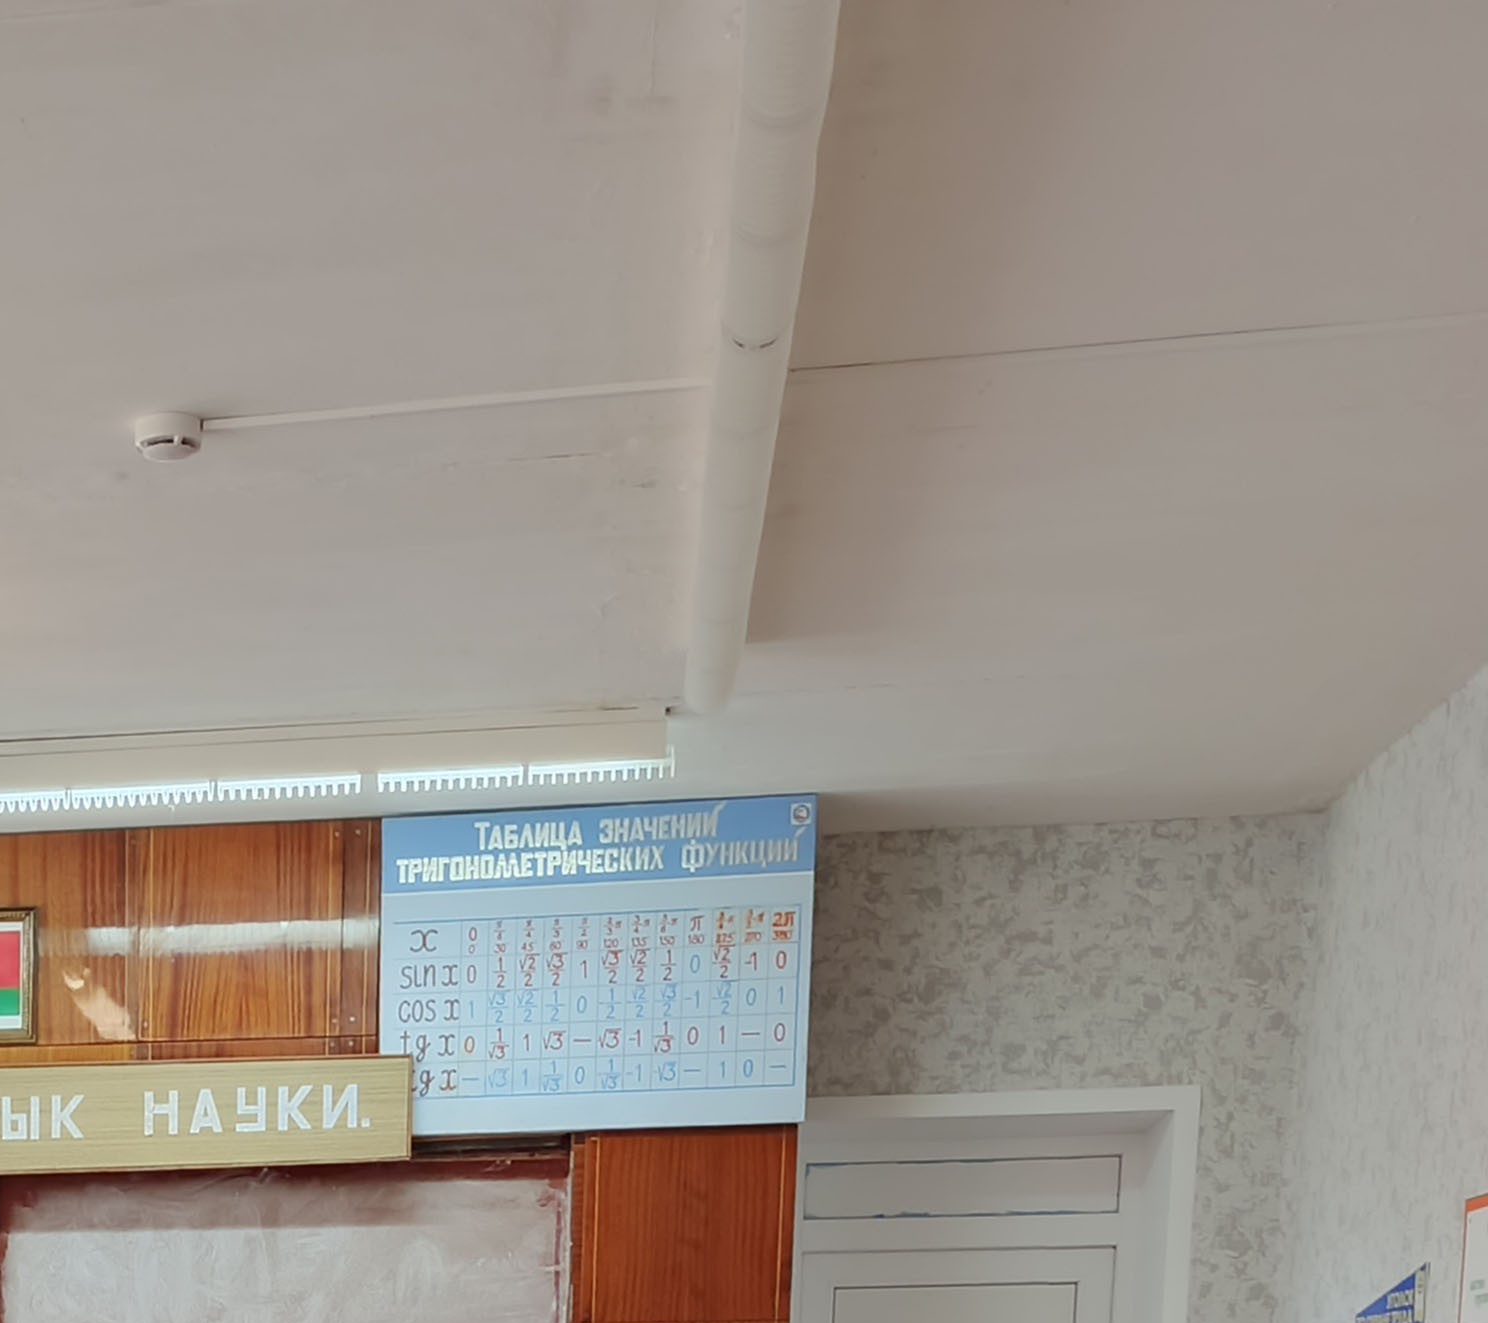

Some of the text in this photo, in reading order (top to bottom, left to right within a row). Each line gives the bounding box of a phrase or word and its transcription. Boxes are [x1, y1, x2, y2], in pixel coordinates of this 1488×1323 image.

[474, 801, 728, 851] ТАБЛИЦА ЗНАЧЕНИЙ
[396, 827, 807, 884] ТРИГОНОМЕТРИЧЕСКИХ ФУНКЦИЙ
[144, 1084, 371, 1136] НАУКИ.
